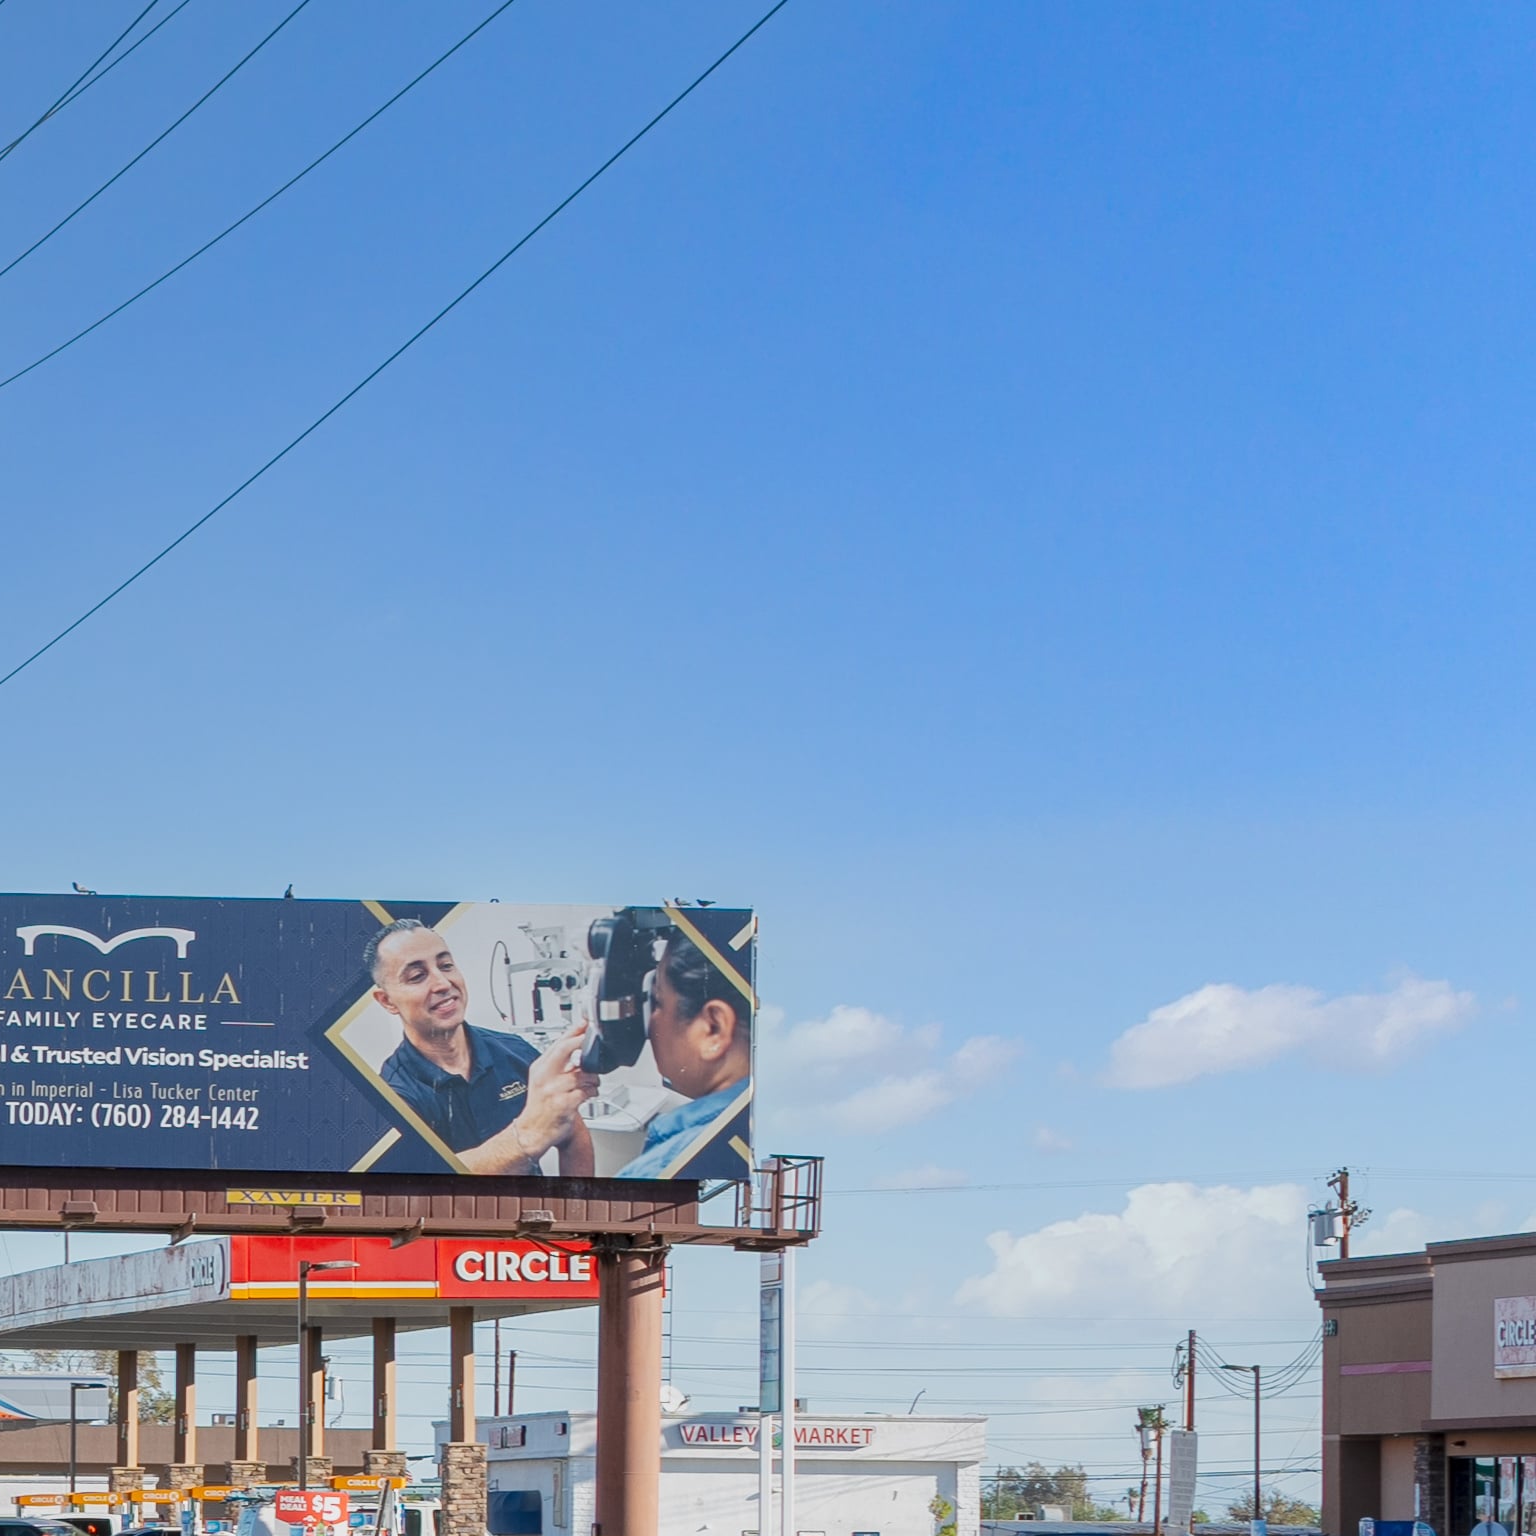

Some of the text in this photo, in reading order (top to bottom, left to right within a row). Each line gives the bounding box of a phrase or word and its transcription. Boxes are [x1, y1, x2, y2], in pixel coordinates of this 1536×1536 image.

[93, 1012, 208, 1030] EYECARE
[10, 1045, 29, 1064] &
[32, 1045, 122, 1066] Trusted
[124, 1047, 195, 1067] Vision
[198, 1049, 310, 1071] Specialist
[11, 1081, 25, 1097] in
[31, 1080, 94, 1102] Imperial
[113, 1081, 143, 1099] Lisa
[150, 1082, 201, 1101] Tucker
[208, 1083, 260, 1102] Center
[5, 1101, 84, 1127] TODAY:
[91, 1102, 152, 1129] (760)
[160, 1104, 260, 1130] 284-1442
[240, 1190, 348, 1204] XAVIER
[455, 1250, 592, 1282] CIRCLE
[1497, 1319, 1536, 1348] CIRCLE
[682, 1426, 873, 1444] VALLEY MARKET
[312, 1495, 342, 1521] $5
